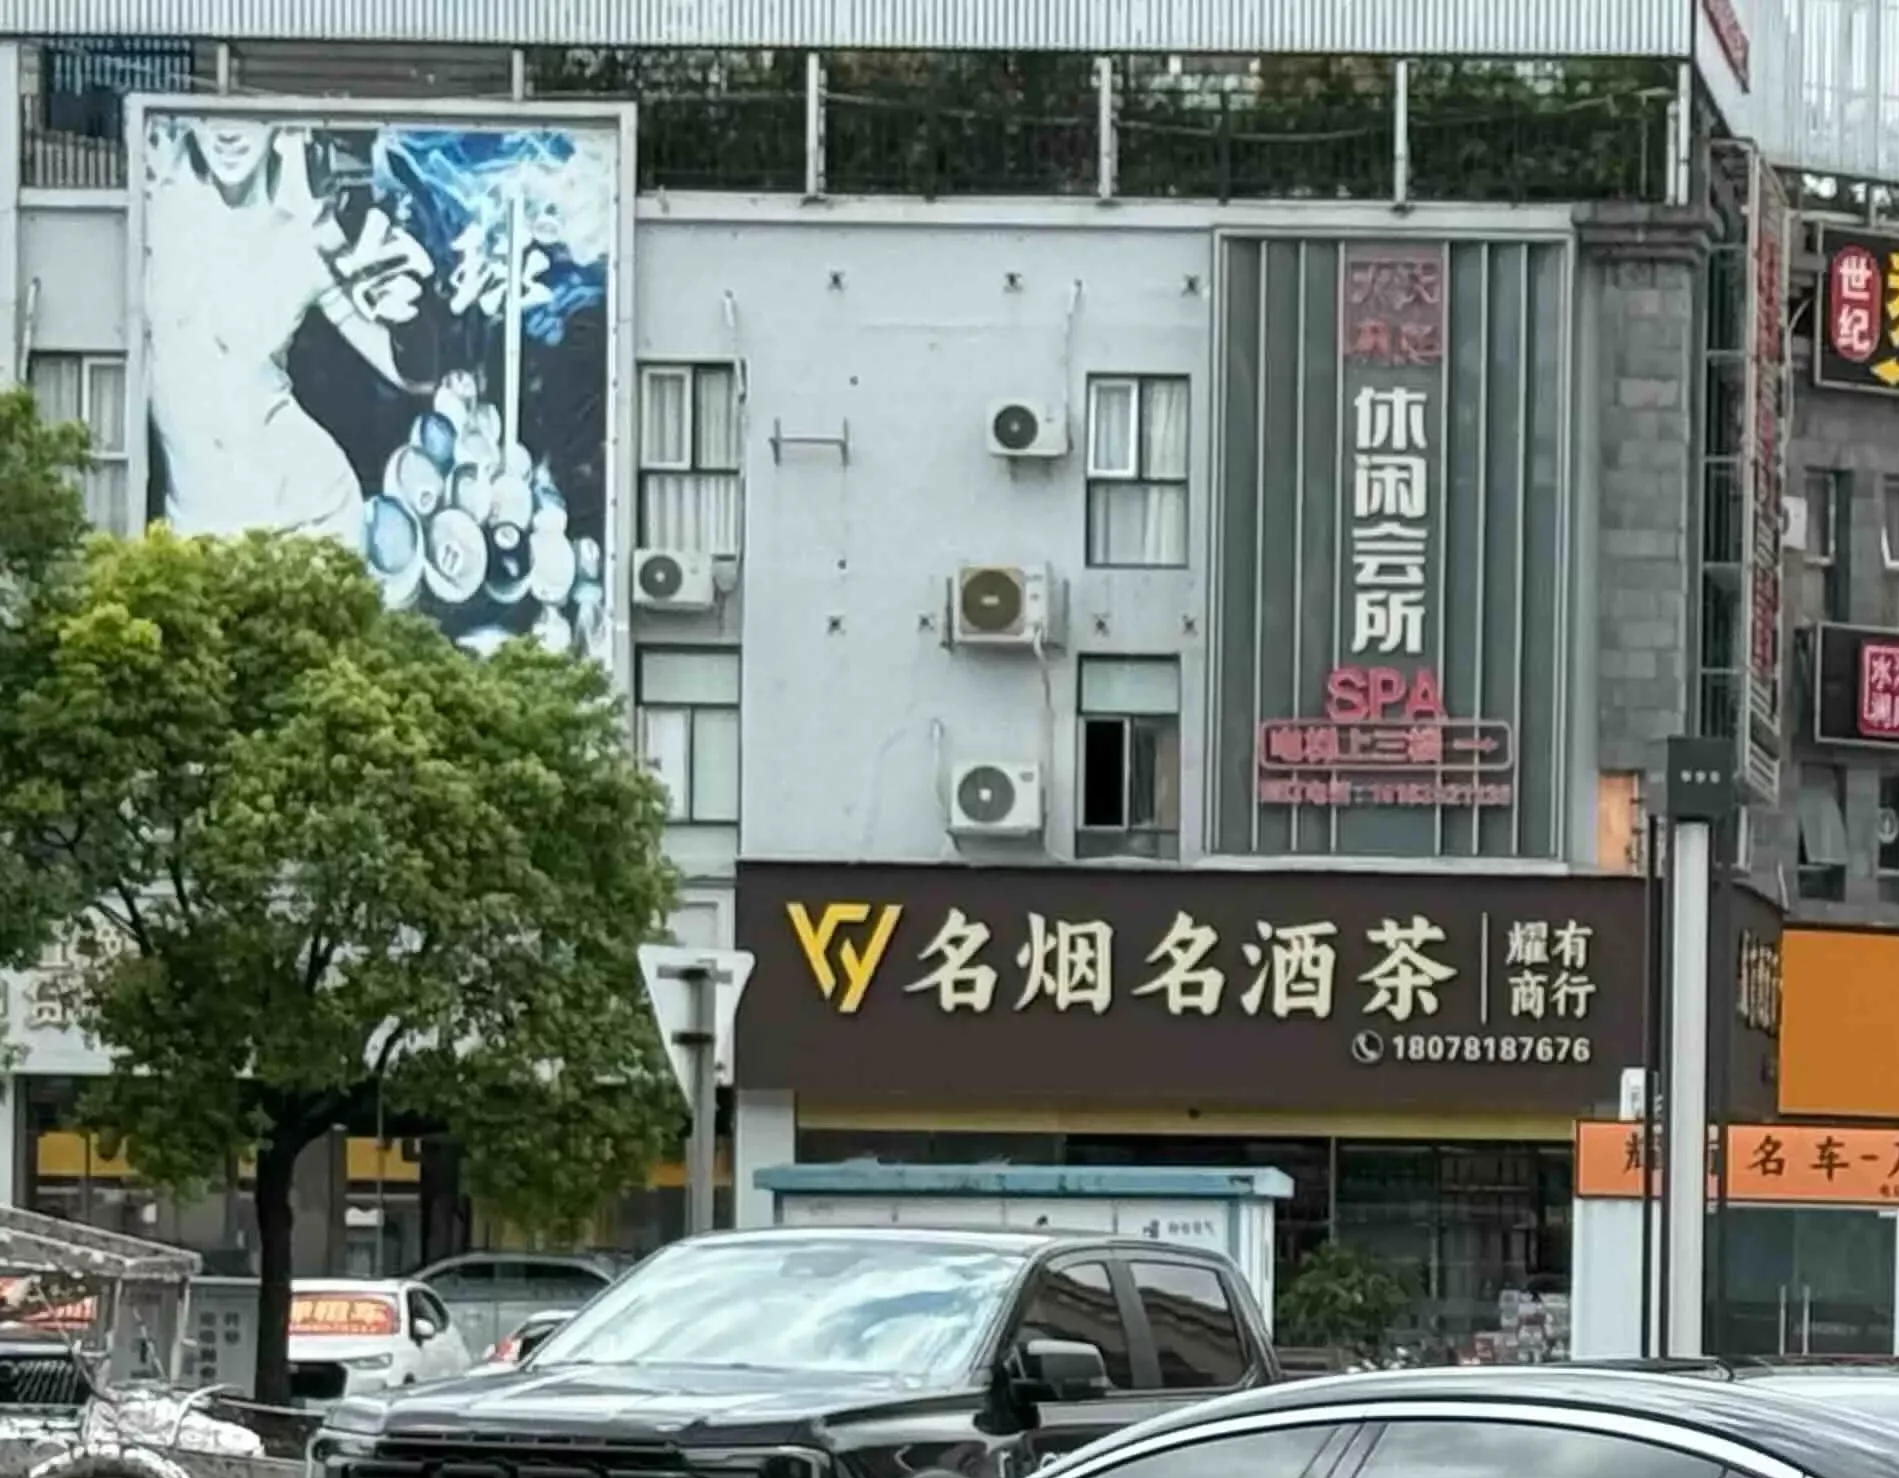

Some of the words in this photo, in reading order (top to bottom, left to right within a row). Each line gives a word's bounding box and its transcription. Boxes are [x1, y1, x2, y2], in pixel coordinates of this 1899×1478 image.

[1836, 254, 1874, 354] 世纪
[1352, 384, 1428, 654] 休闲会所
[1325, 666, 1446, 724] SPA
[902, 906, 1459, 1022] 名烟名酒茶
[1505, 919, 1594, 968] 耀有
[1508, 970, 1597, 1020] 商行
[1391, 1035, 1593, 1063] 18078187676
